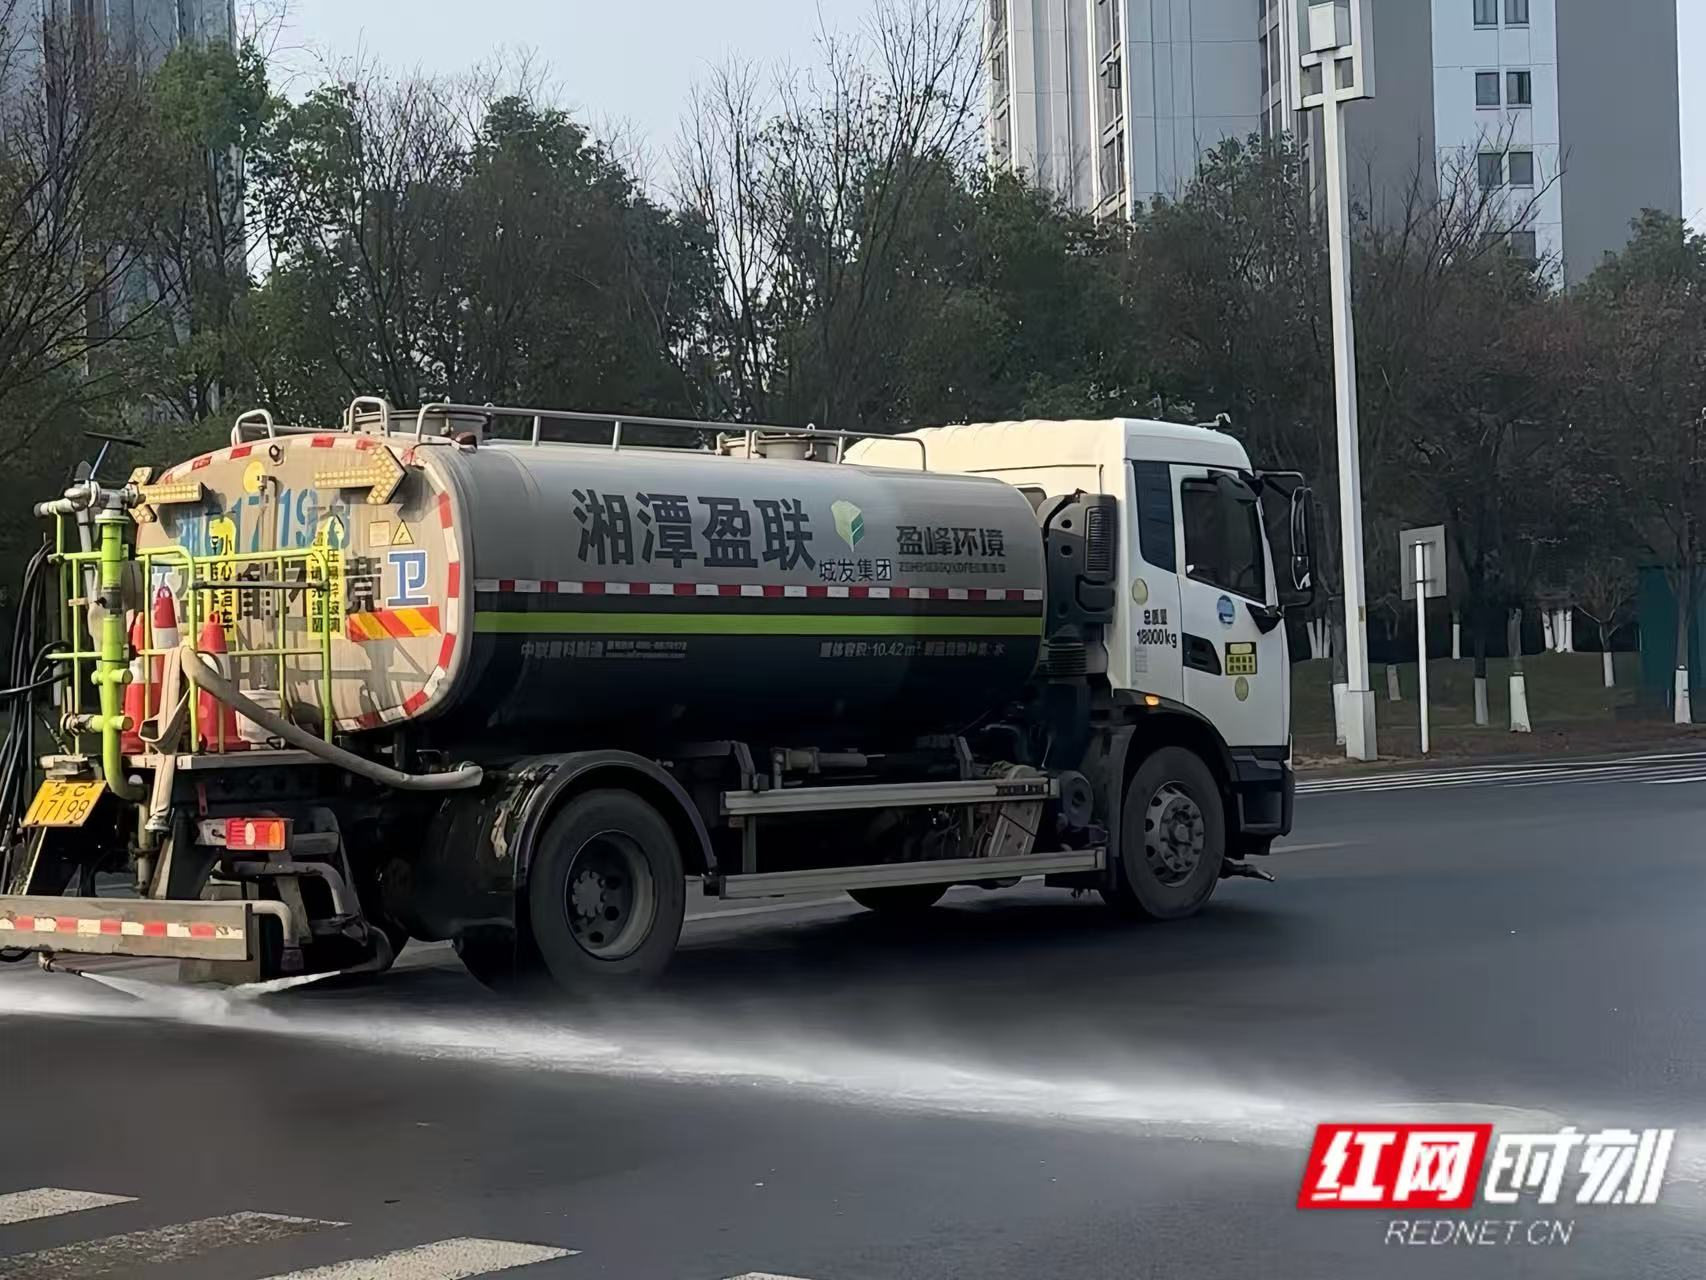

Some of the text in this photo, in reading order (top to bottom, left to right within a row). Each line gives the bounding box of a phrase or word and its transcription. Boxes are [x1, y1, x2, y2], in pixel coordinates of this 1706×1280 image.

[572, 488, 816, 571] 湘潭盈联
[895, 526, 1007, 557] 盈峰环境
[386, 550, 431, 607] 卫
[819, 557, 893, 583] 城发集团
[1136, 628, 1177, 649] 18000kg
[33, 799, 90, 822] 17198
